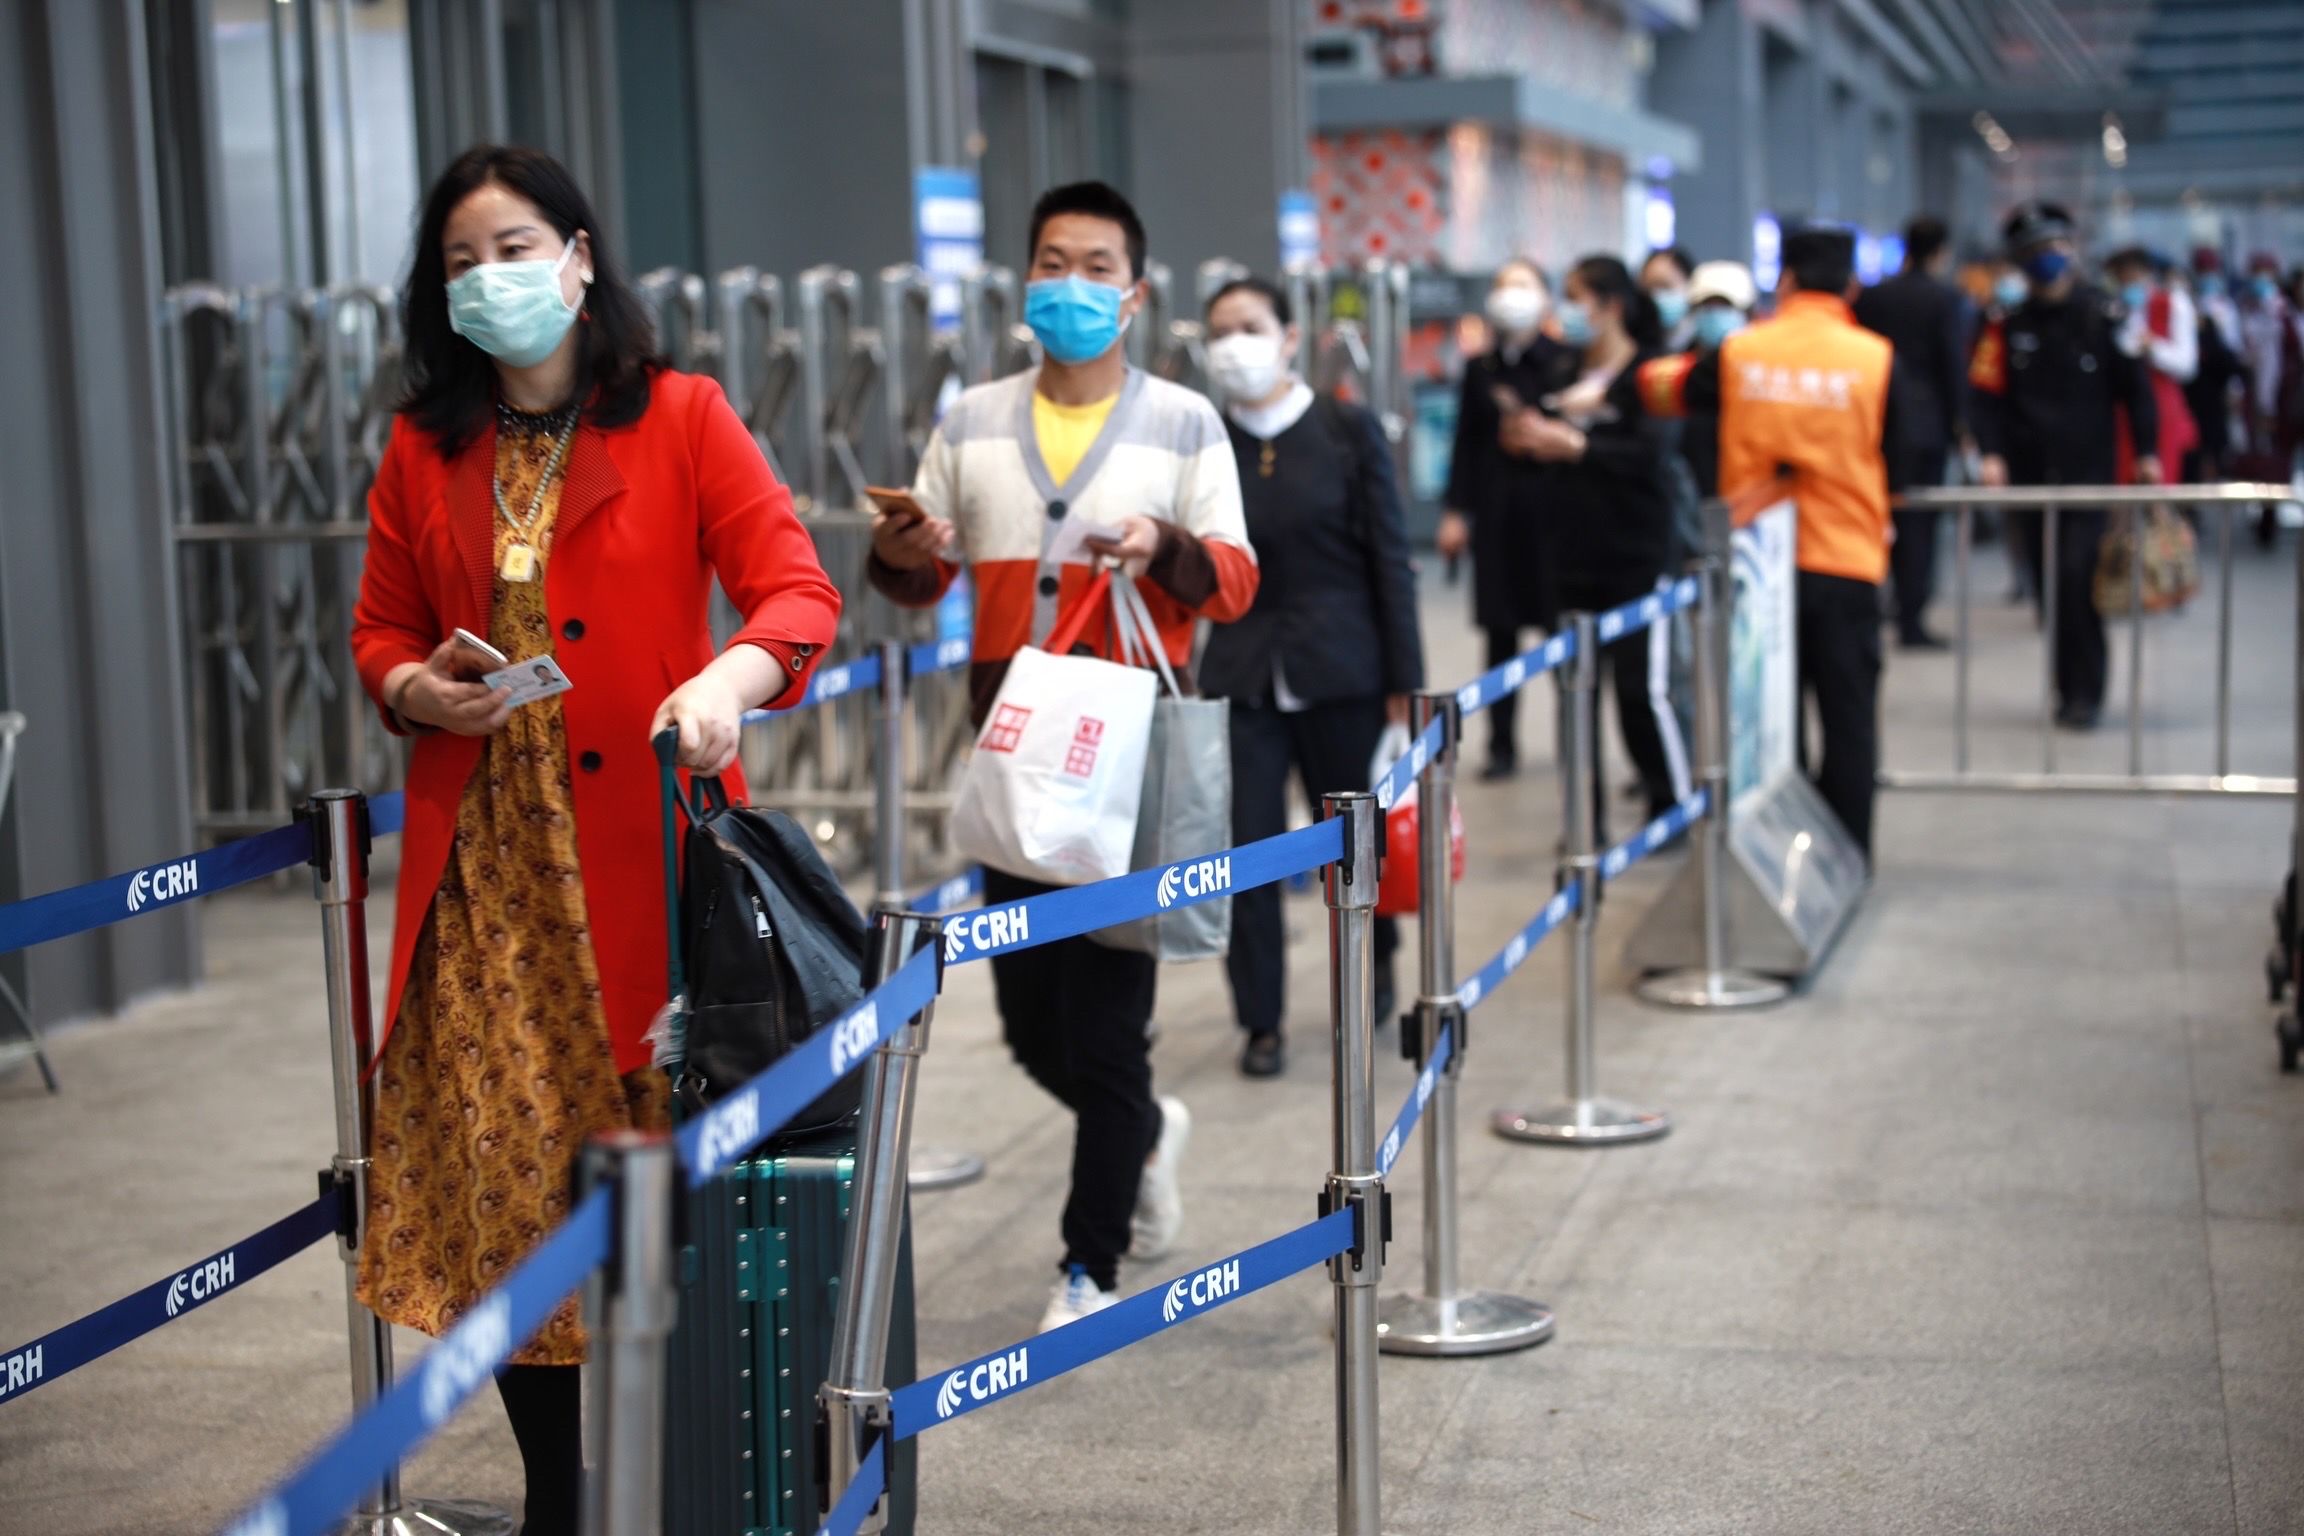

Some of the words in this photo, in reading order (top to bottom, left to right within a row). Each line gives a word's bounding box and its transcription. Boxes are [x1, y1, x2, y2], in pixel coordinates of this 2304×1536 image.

[152, 859, 198, 901] CRH
[1183, 855, 1231, 898] CRH
[971, 905, 1029, 951] CRH
[191, 1252, 235, 1300] CRH
[1190, 1258, 1240, 1306] CRH
[969, 1347, 1028, 1400] CRH
